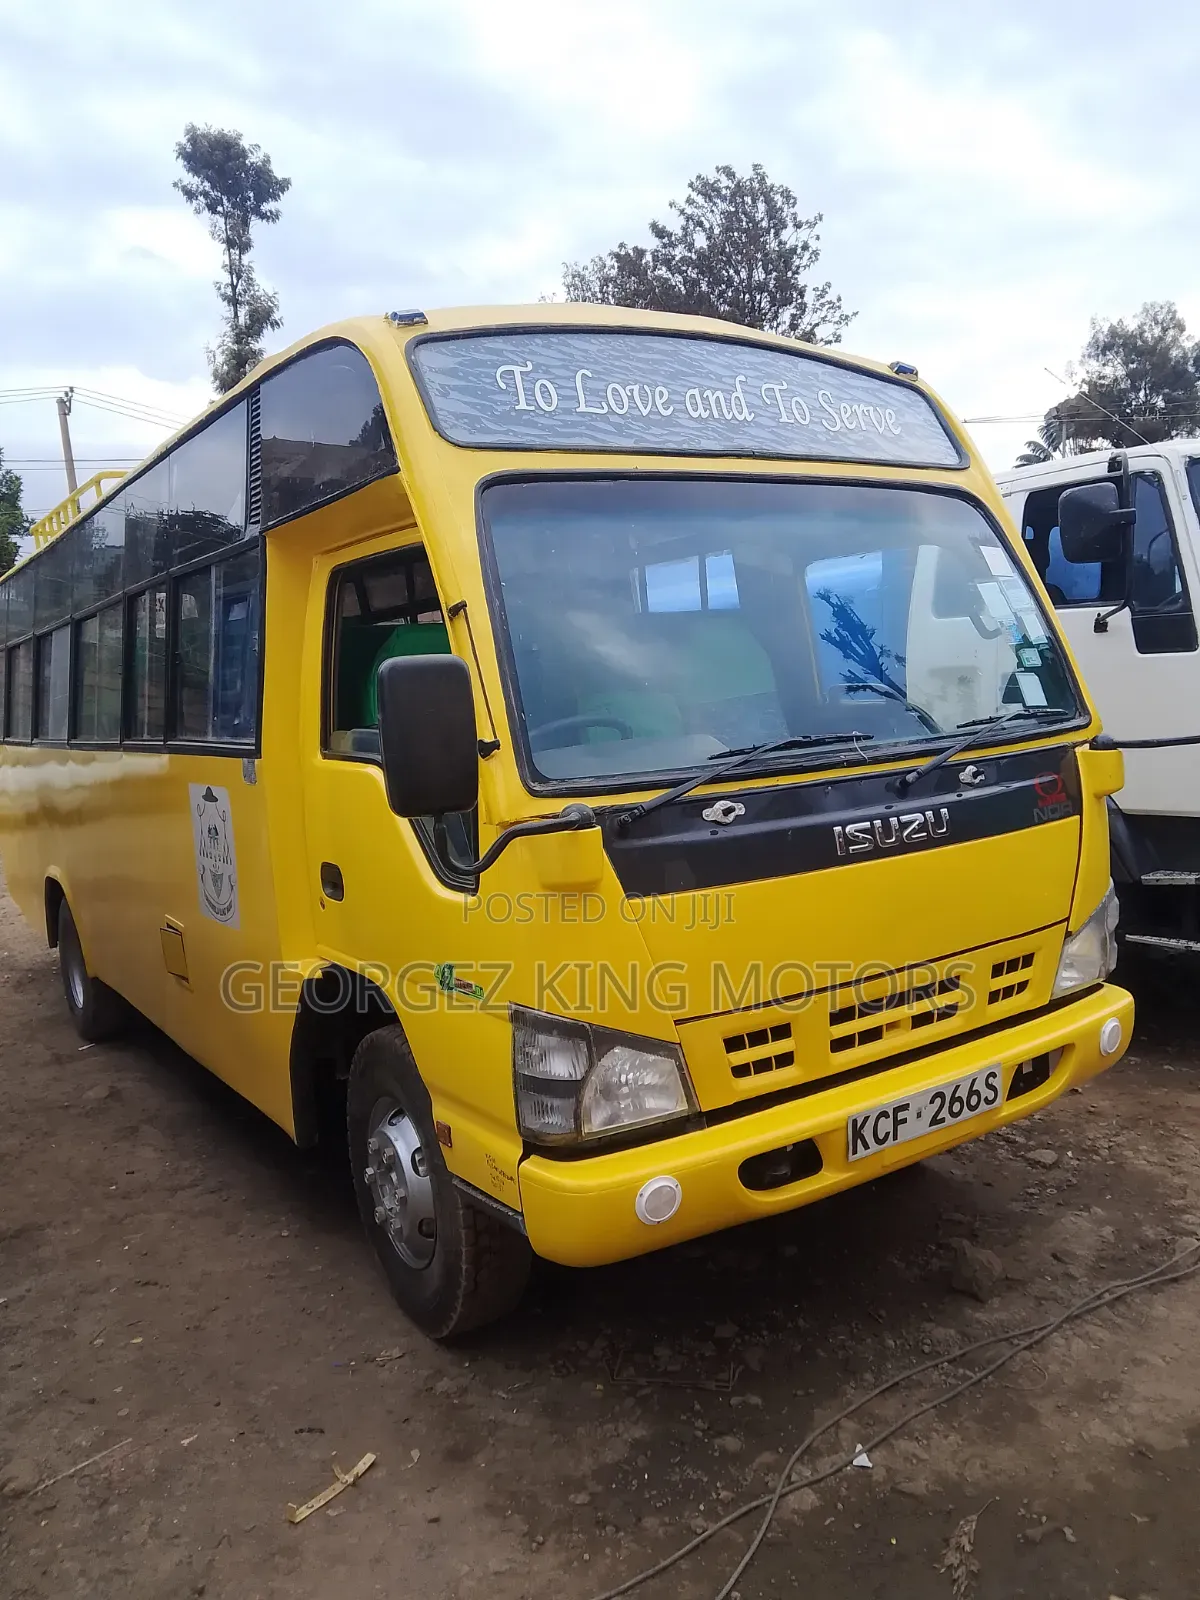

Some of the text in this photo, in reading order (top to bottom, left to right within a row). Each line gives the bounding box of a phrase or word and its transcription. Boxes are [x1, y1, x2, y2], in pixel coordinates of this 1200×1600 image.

[495, 360, 902, 435] To Love and To Serve
[833, 808, 950, 855] ISUZU
[851, 1071, 999, 1156] KCF 266S
